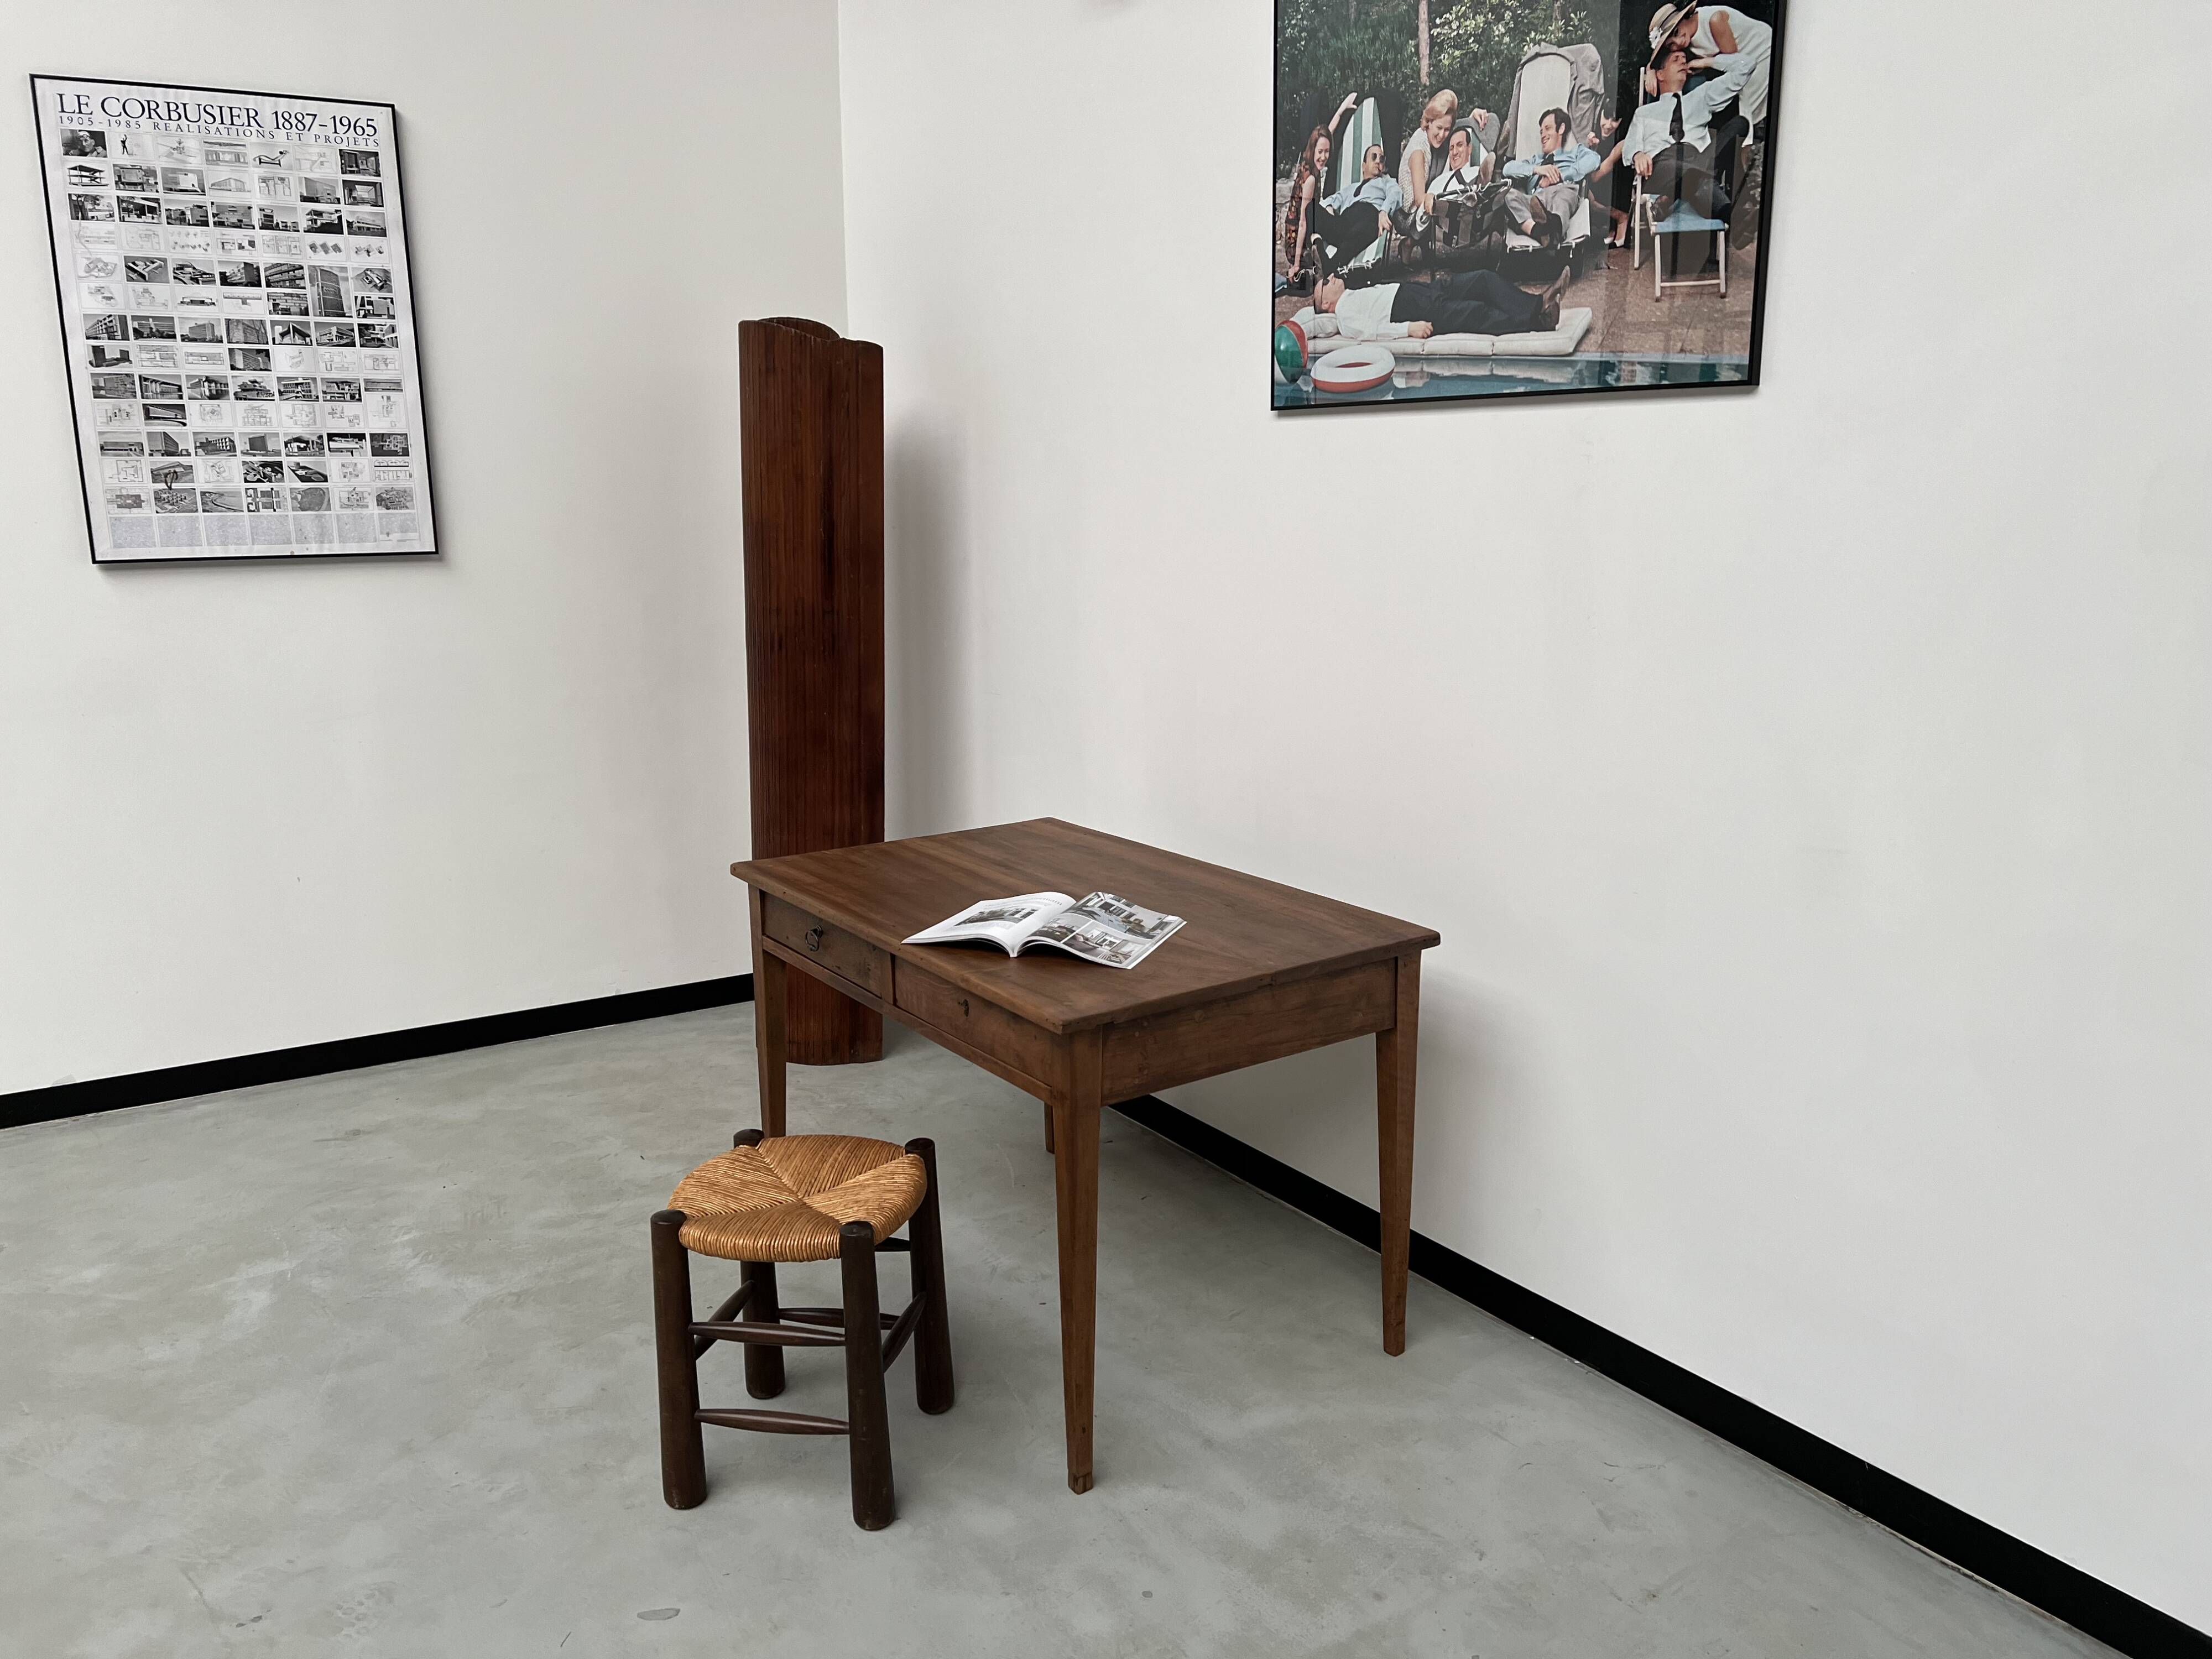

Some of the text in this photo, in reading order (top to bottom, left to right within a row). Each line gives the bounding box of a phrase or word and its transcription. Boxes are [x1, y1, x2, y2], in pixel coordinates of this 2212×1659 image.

[56, 93, 378, 137] LE CORBUSIER 1887-1965
[59, 115, 380, 148] 1905-1985 REALISATIONS ET PROJETS
